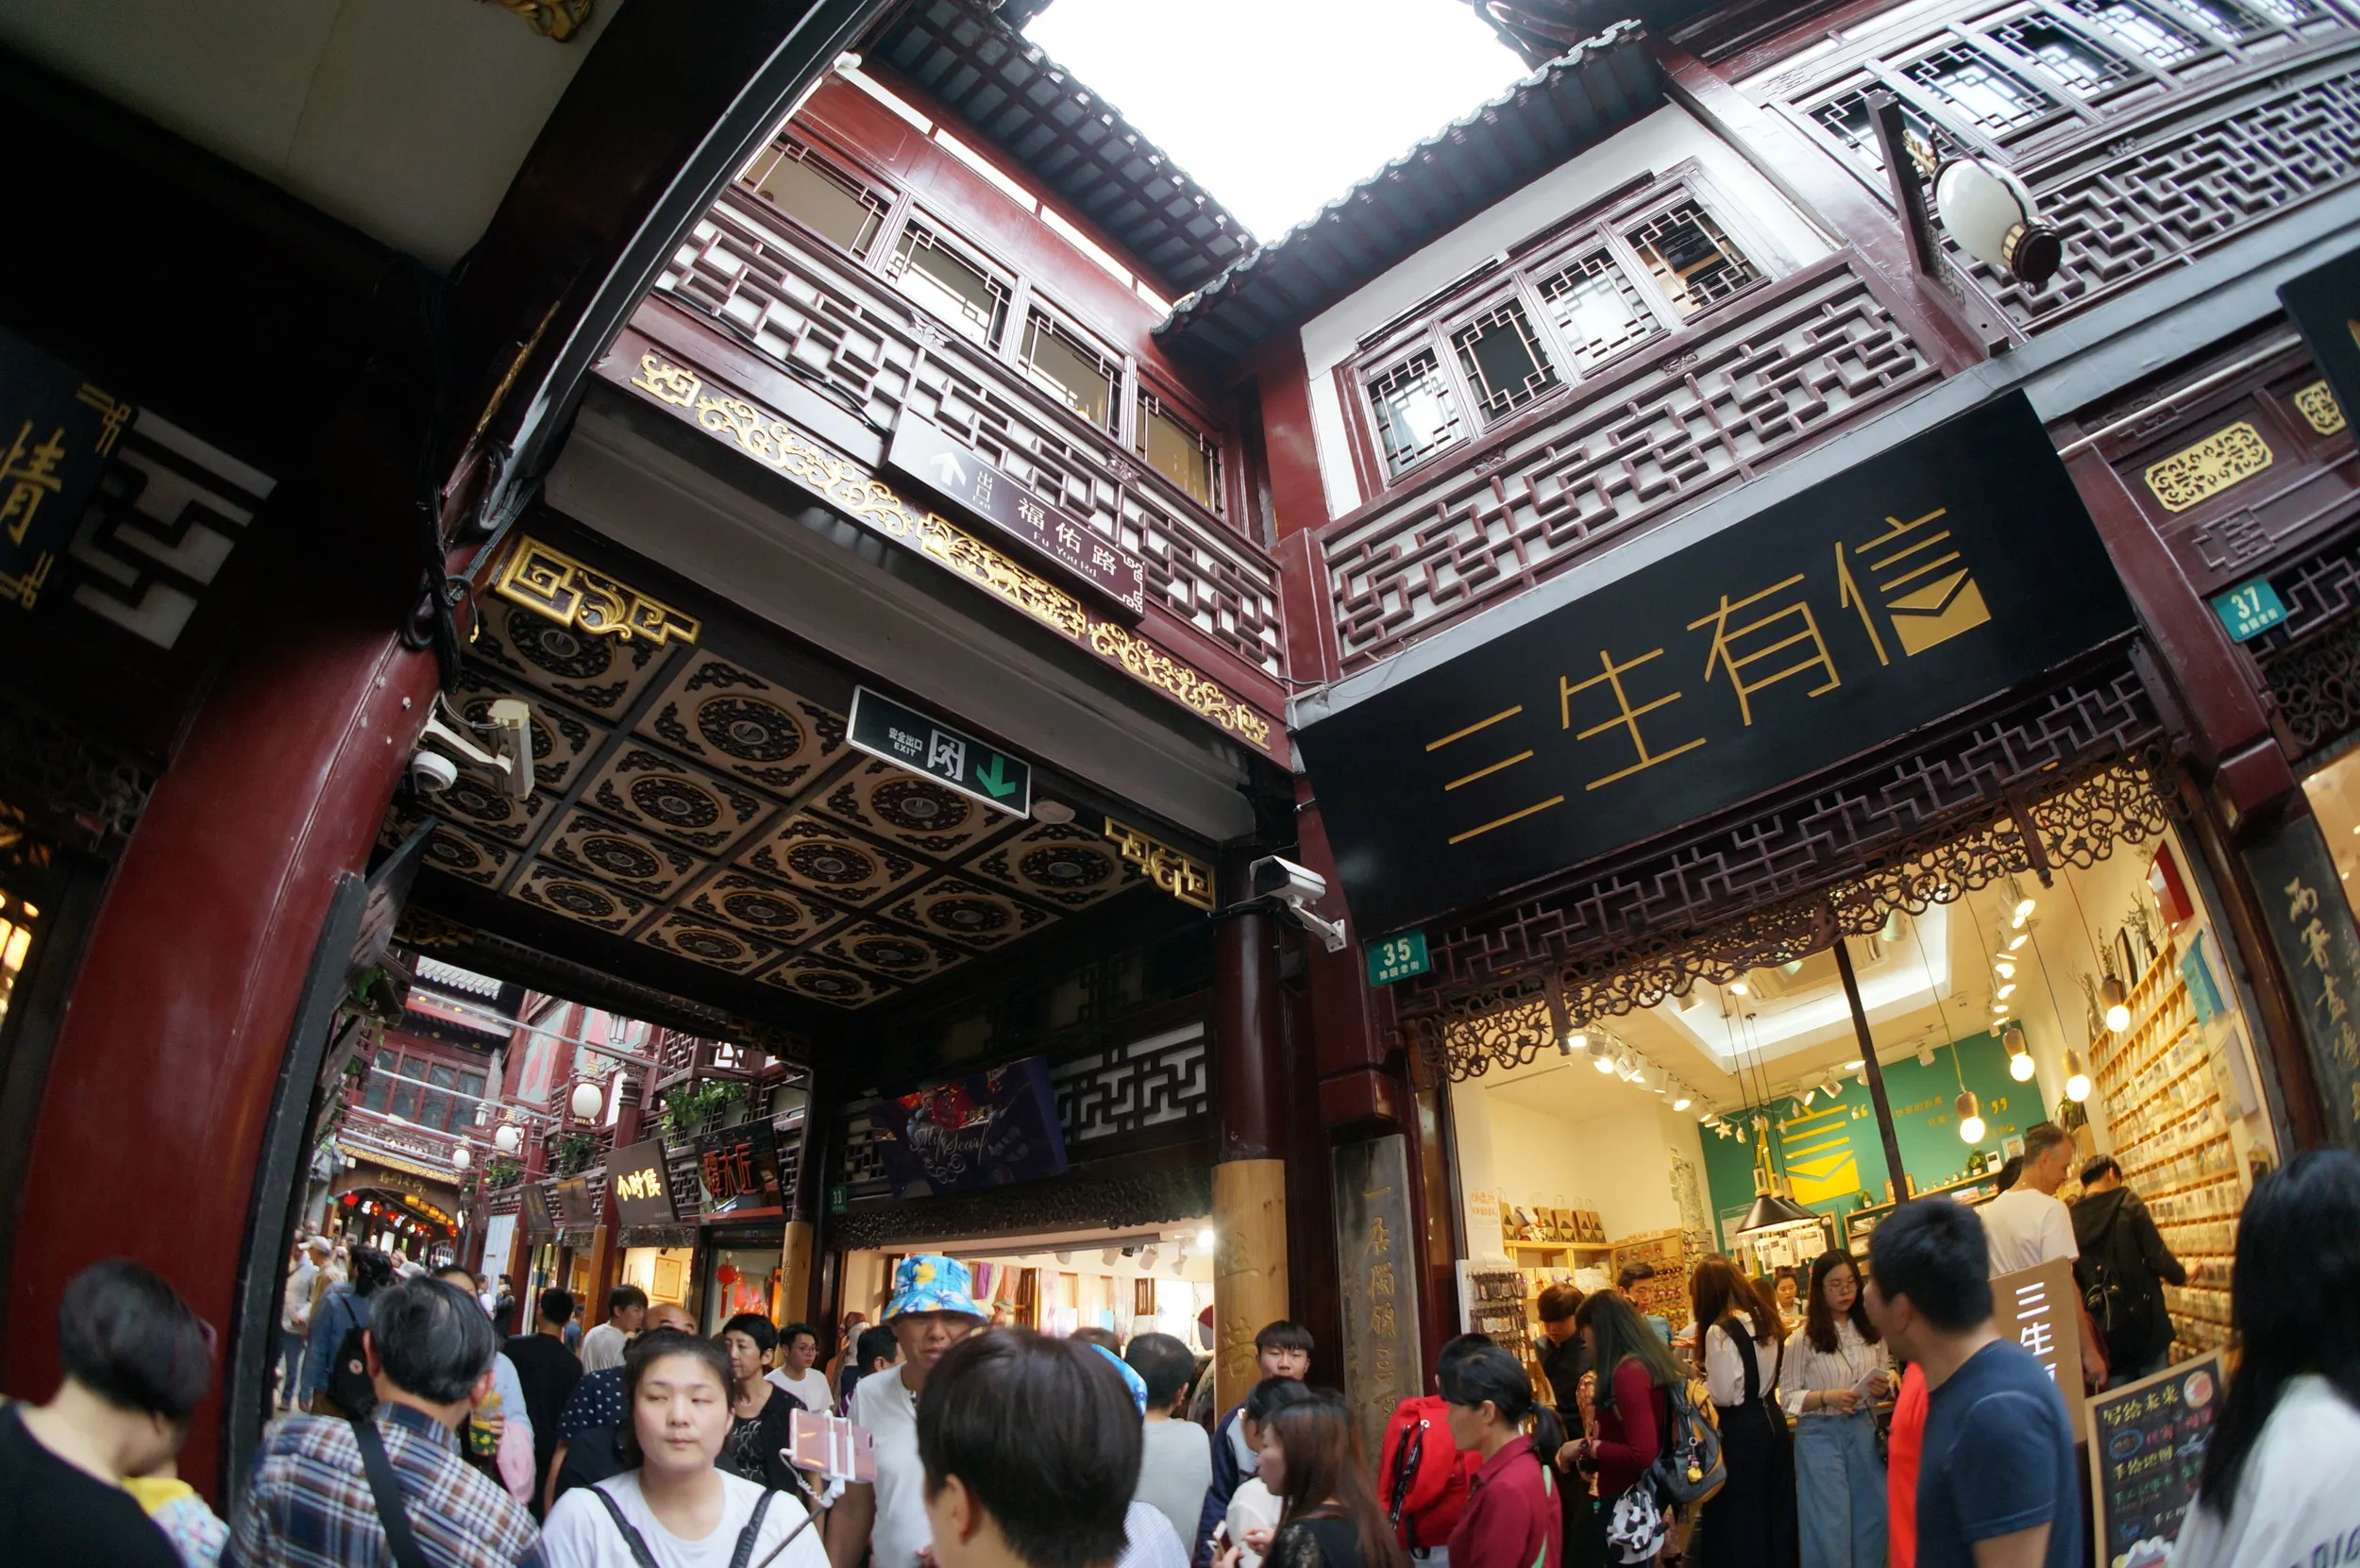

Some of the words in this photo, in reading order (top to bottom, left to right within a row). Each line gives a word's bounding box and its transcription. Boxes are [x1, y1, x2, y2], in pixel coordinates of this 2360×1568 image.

[976, 470, 993, 503] 出口
[1018, 497, 1117, 576] 福佑路
[1033, 531, 1051, 548] Fu
[1055, 545, 1078, 566] You
[2231, 585, 2261, 619] 37
[1425, 508, 1992, 845] 三生有信
[888, 727, 923, 752] 安全出口
[893, 742, 918, 757] EXIT
[1382, 936, 1411, 967] 35
[833, 1189, 843, 1205] 33
[2014, 1281, 2057, 1383] 三生
